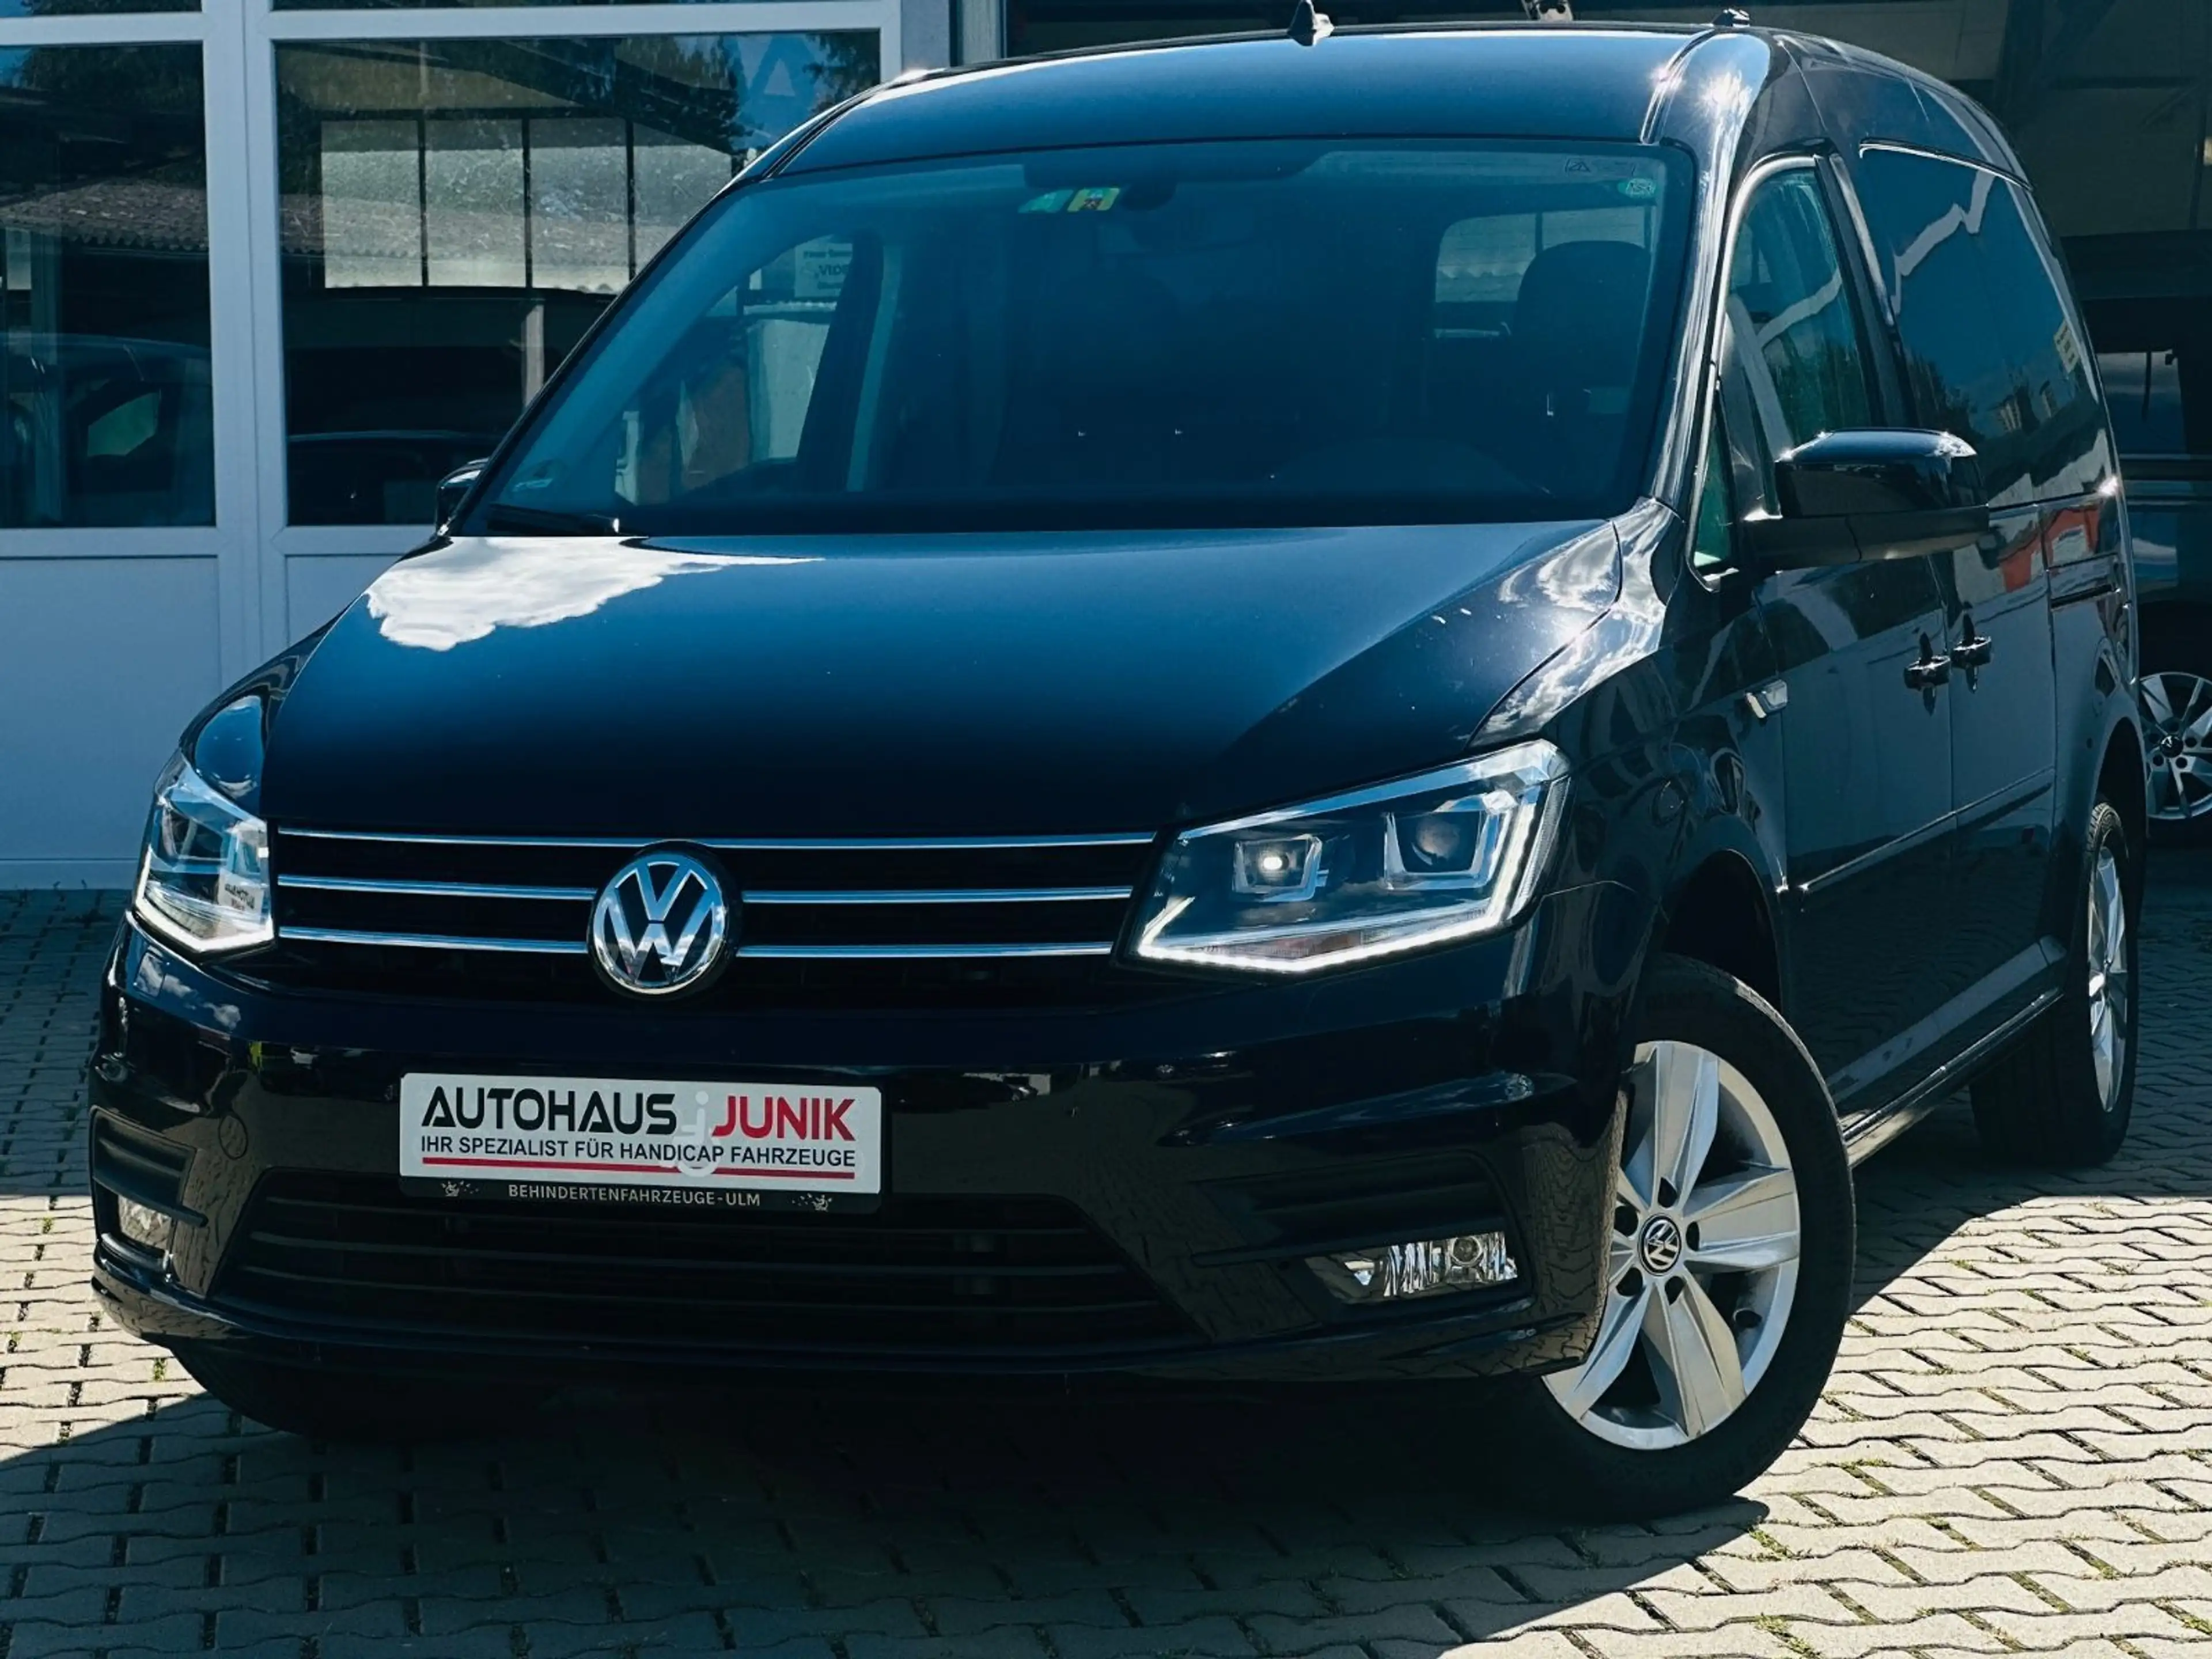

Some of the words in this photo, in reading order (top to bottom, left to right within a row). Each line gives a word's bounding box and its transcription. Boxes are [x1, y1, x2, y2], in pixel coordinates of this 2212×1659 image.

[818, 264, 849, 275] VIDE
[601, 856, 718, 986] VW
[421, 1086, 677, 1135] AUTOHAUS
[711, 1096, 855, 1141] JUNIK
[421, 1135, 452, 1152] IHR
[459, 1137, 569, 1156] SPEZIALIST
[575, 1138, 613, 1158] FÜR
[620, 1143, 724, 1162] HANDICAP
[731, 1147, 855, 1166] FAHRZEUGE
[508, 1184, 760, 1206] BEHINDERTENFAHRZEUGE-ULM
